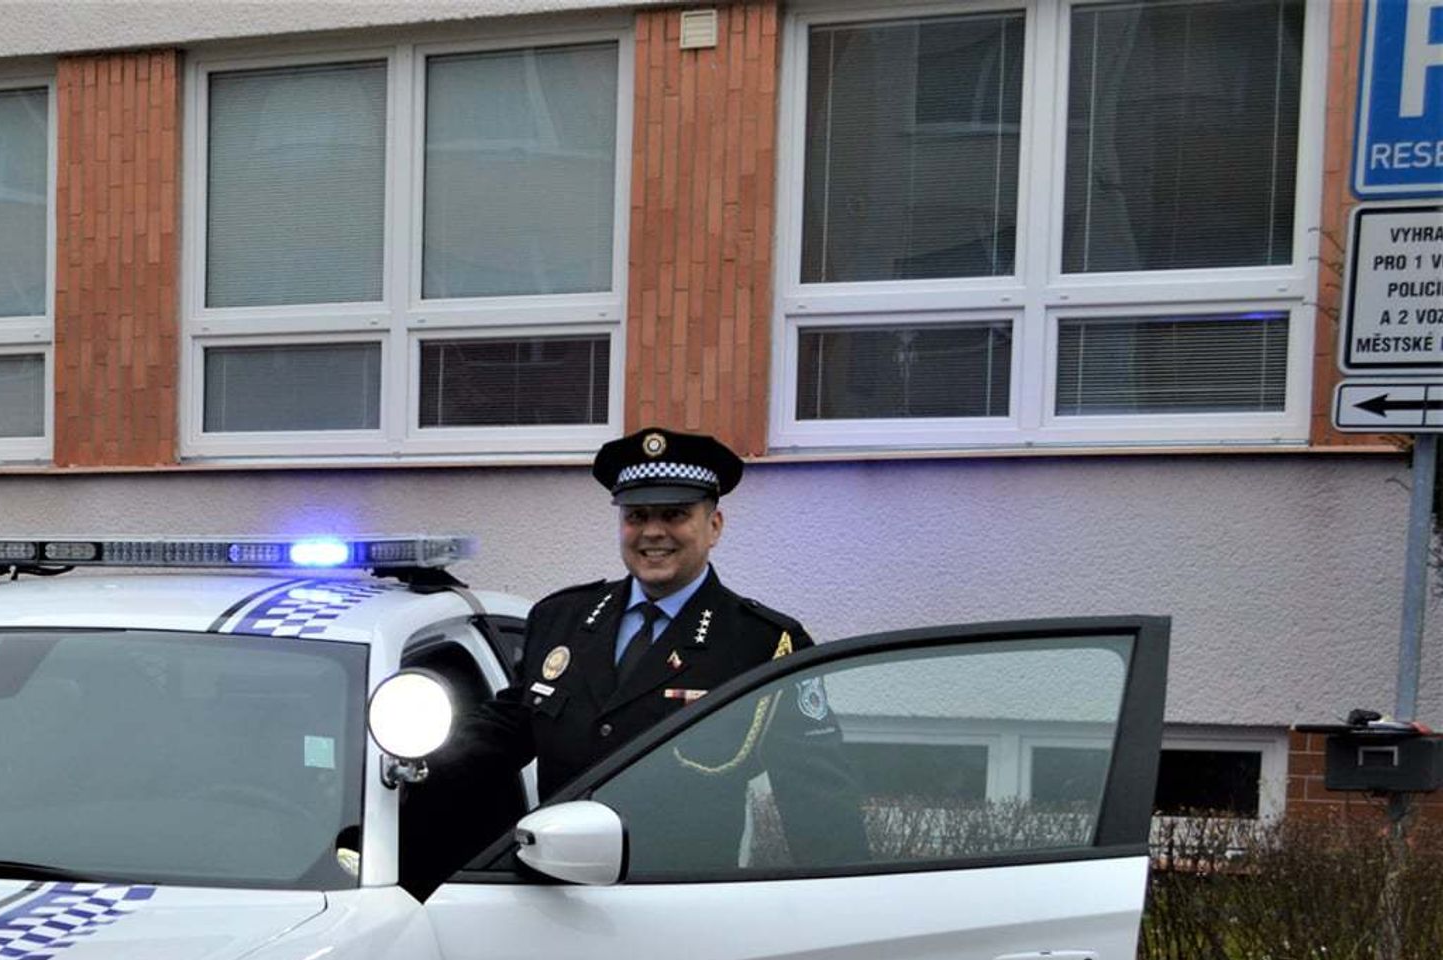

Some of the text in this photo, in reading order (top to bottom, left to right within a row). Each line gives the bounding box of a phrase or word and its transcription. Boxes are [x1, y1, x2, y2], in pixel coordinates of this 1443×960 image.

[1373, 253, 1443, 271] PRO 1 V
[1387, 281, 1443, 299] POLICI
[1379, 310, 1391, 326] A
[1398, 309, 1410, 325] 2
[1357, 332, 1434, 353] MĚSTSKÉ
